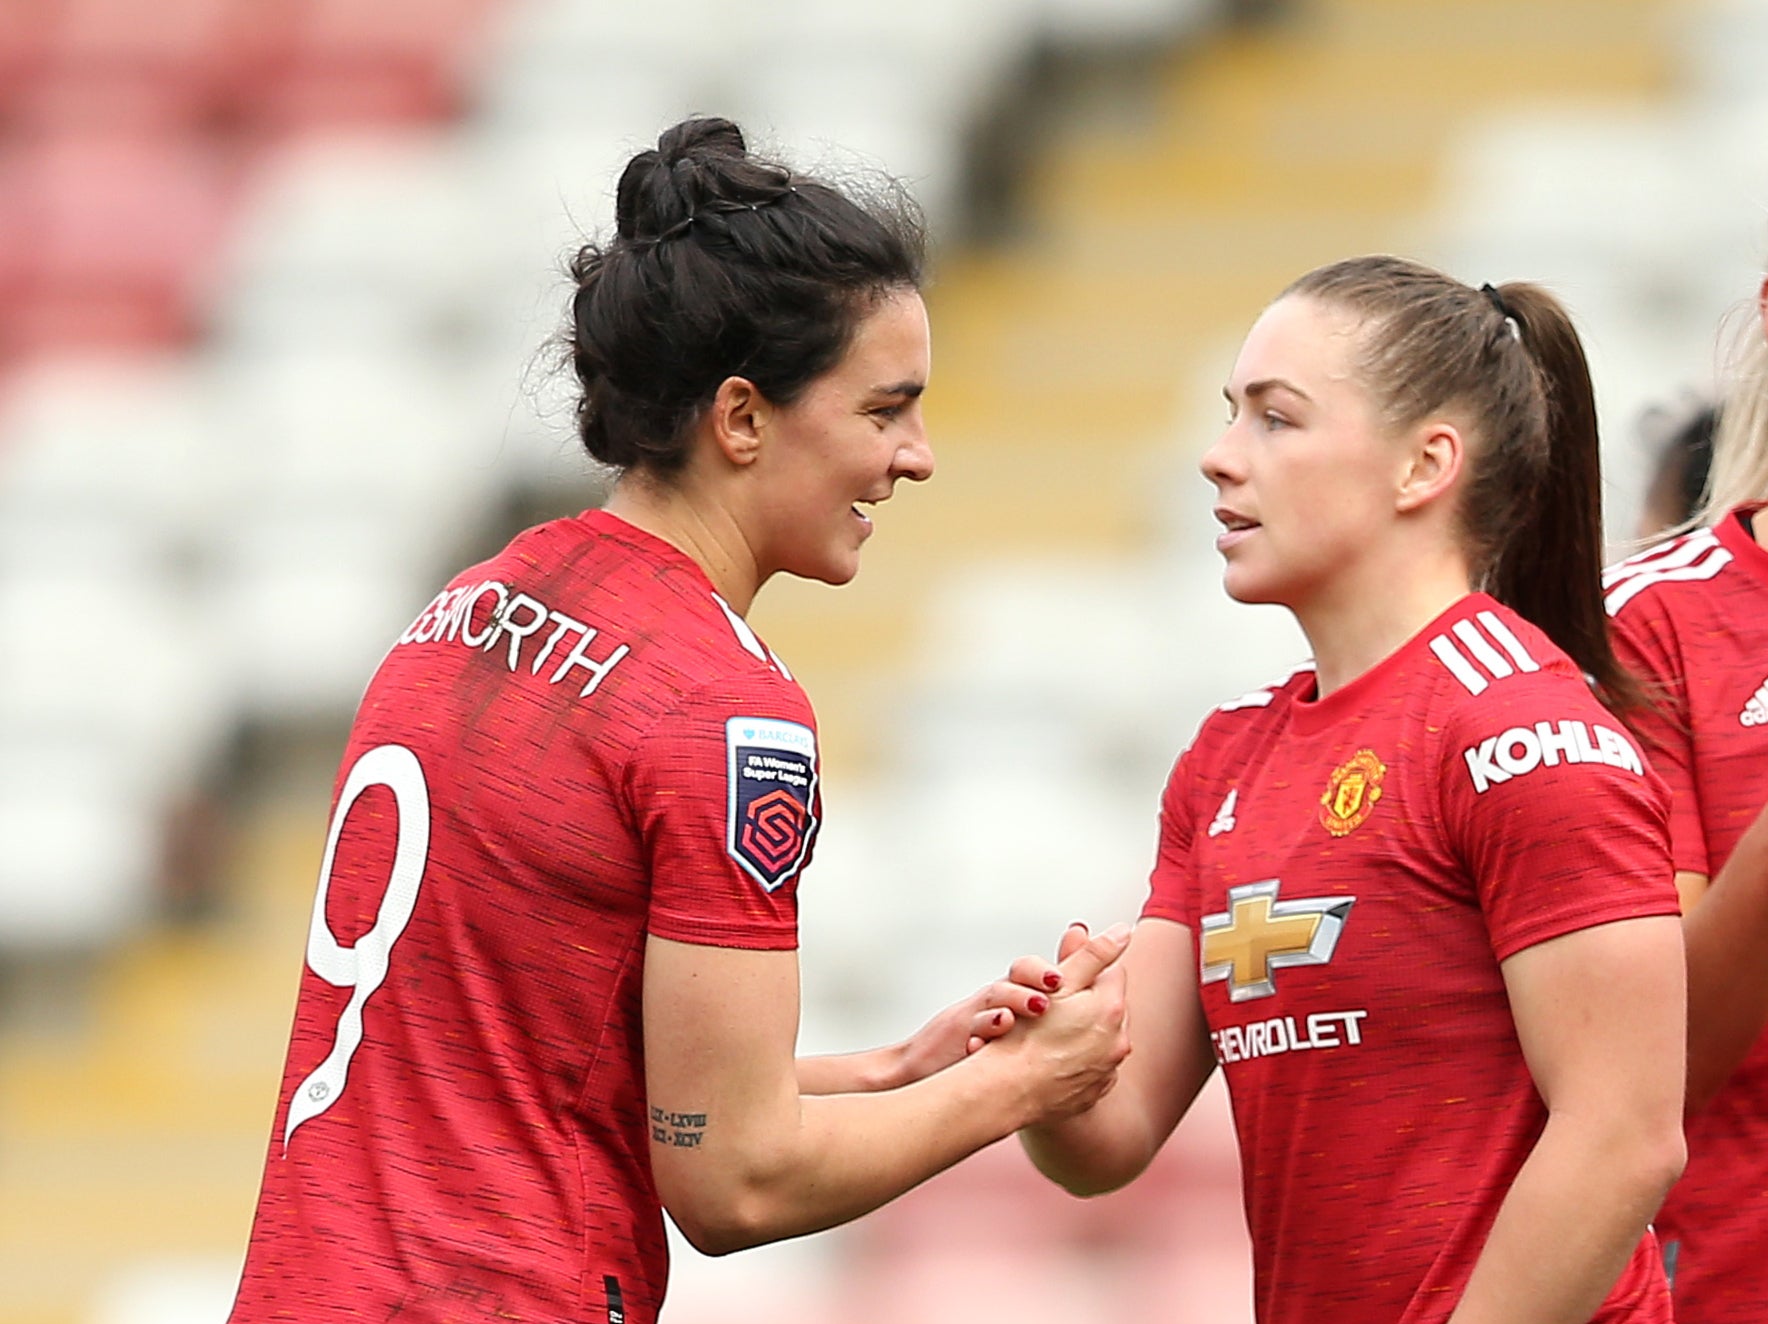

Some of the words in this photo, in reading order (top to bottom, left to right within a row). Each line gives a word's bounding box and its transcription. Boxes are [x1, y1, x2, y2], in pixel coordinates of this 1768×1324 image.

[743, 766, 777, 781] Super
[1463, 719, 1645, 794] KOHLER
[282, 743, 431, 1160] 9
